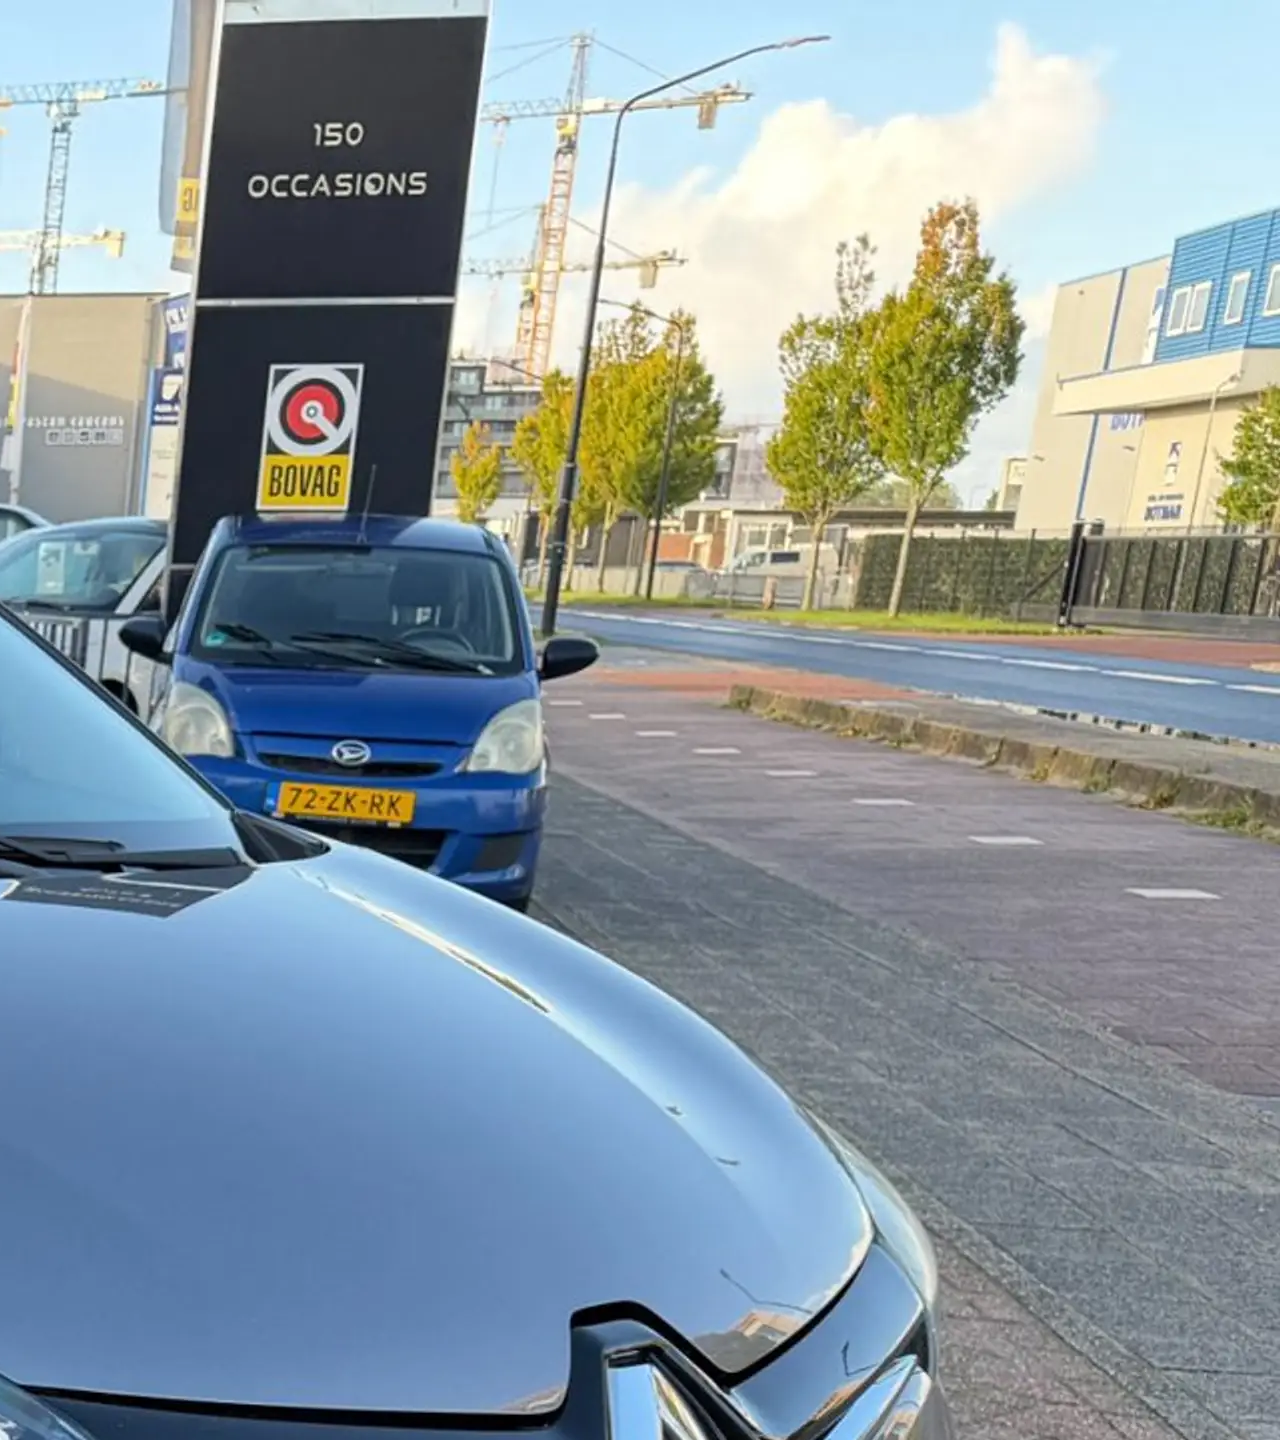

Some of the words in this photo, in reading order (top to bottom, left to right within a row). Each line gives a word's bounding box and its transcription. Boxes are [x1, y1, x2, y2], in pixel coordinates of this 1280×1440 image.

[313, 122, 364, 147] 150
[247, 171, 428, 198] OCCASIONS
[268, 464, 342, 498] BOVAG
[288, 787, 403, 817] 72-ZK-RK
